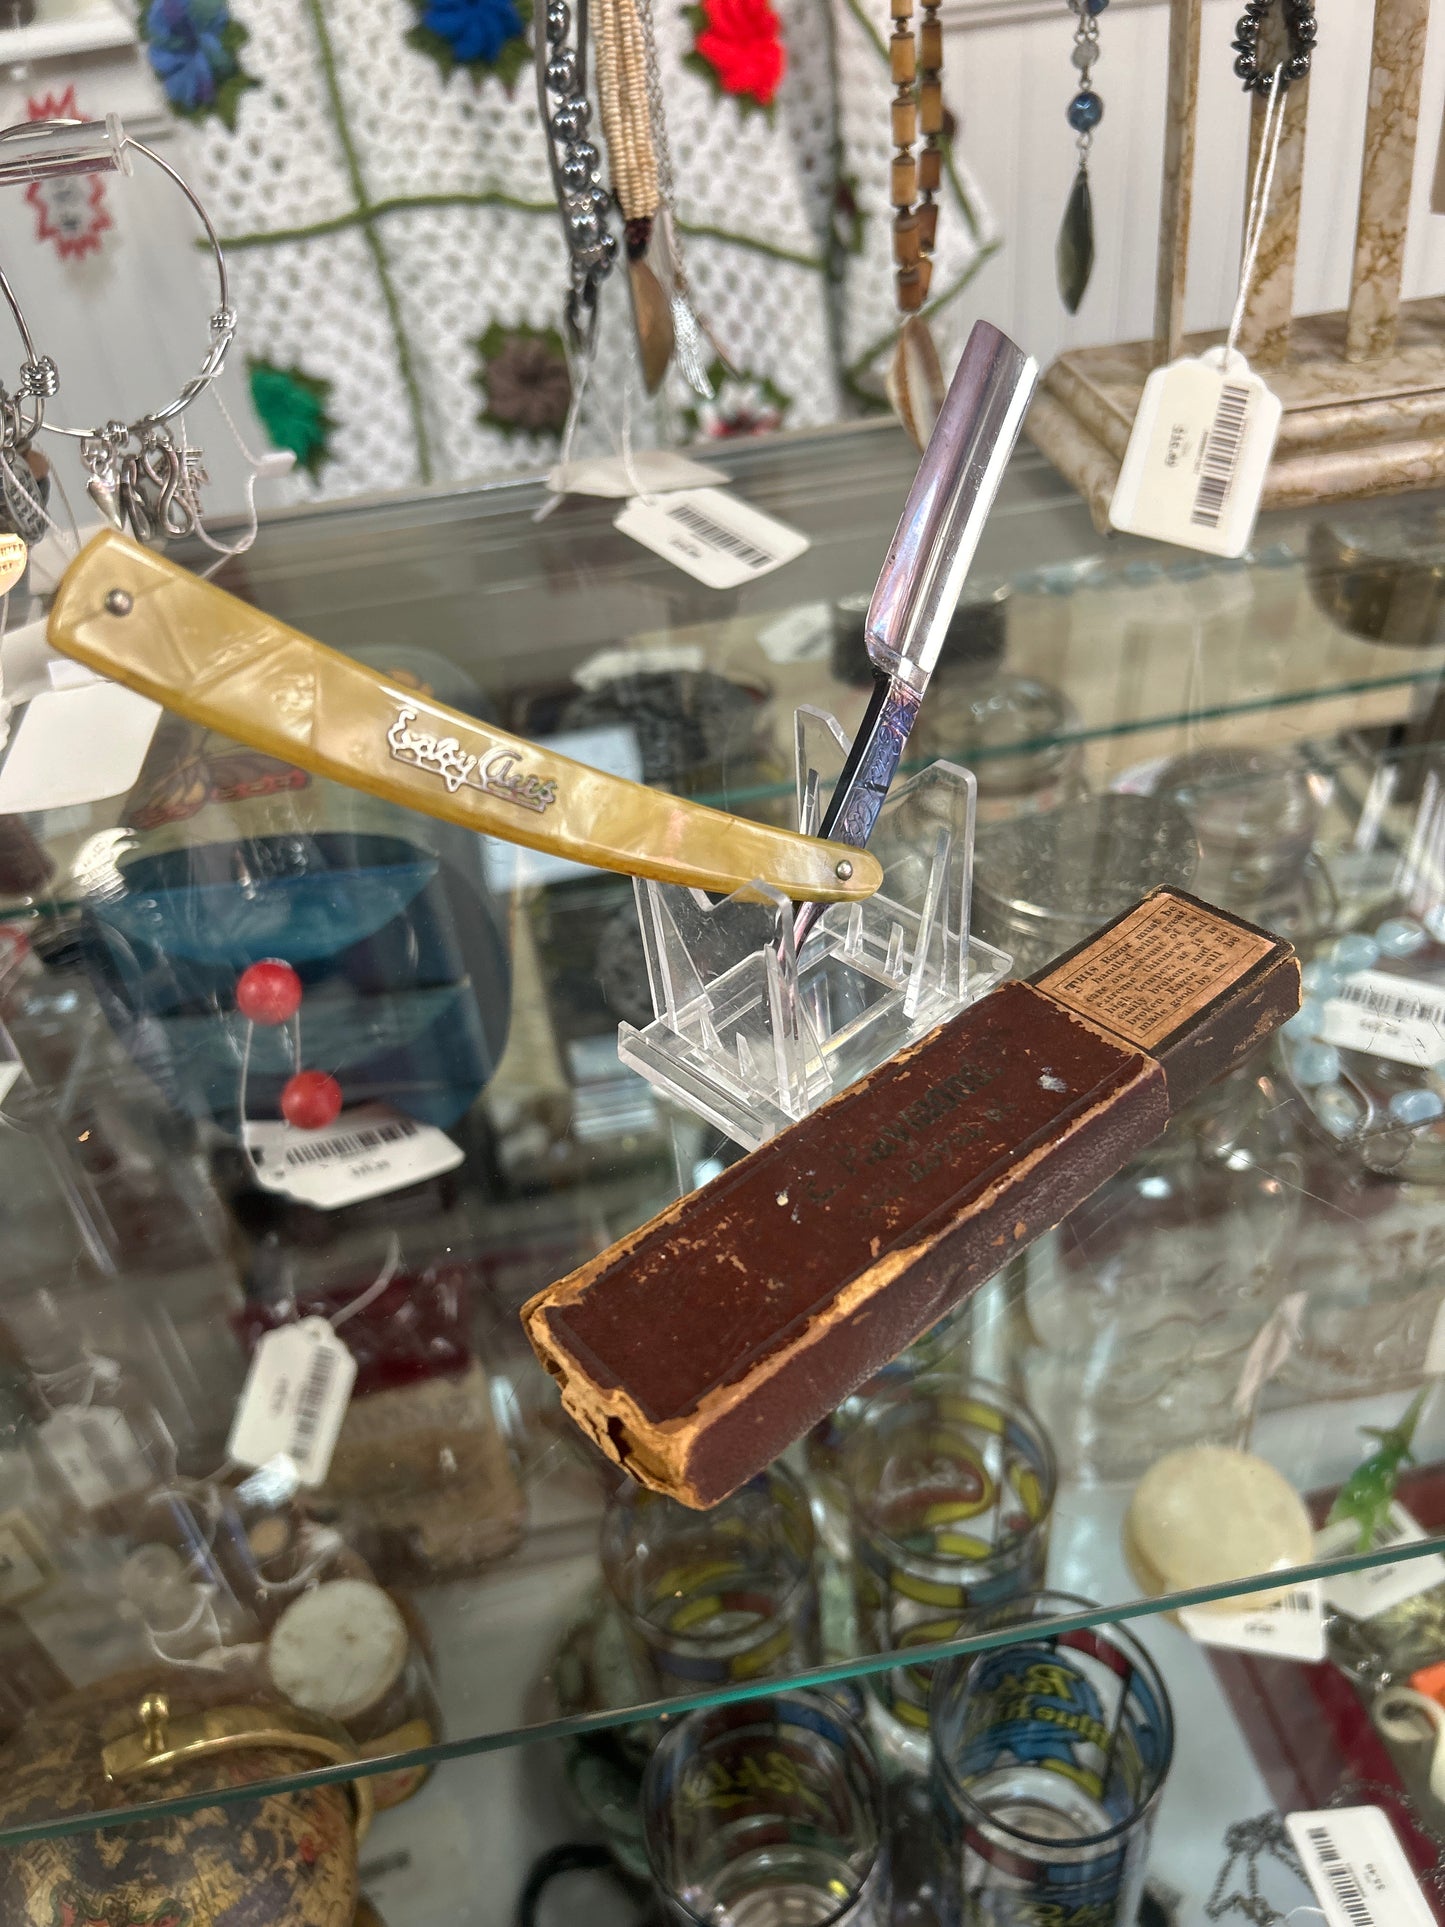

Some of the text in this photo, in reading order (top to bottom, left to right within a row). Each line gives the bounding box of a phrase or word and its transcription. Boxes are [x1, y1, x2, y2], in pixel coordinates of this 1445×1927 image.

[1085, 915, 1198, 1003] care on account of its
[1092, 910, 1186, 984] handled with great
[1101, 942, 1132, 963] Razor
[1134, 920, 1161, 940] must
[1162, 906, 1177, 917] be
[1104, 995, 1132, 1014] high
[1176, 951, 1189, 961] as
[1191, 937, 1203, 947] it
[1206, 925, 1218, 934] is
[1118, 996, 1147, 1019] easily
[1191, 947, 1210, 963] and
[1214, 931, 1229, 942] no
[1142, 941, 1185, 972] thinness
[1187, 921, 1207, 938] and
[1126, 936, 1240, 1025] broken Razor will be
[1139, 1008, 1168, 1031] made
[1170, 987, 1196, 1008] good
[1195, 975, 1210, 986] by
